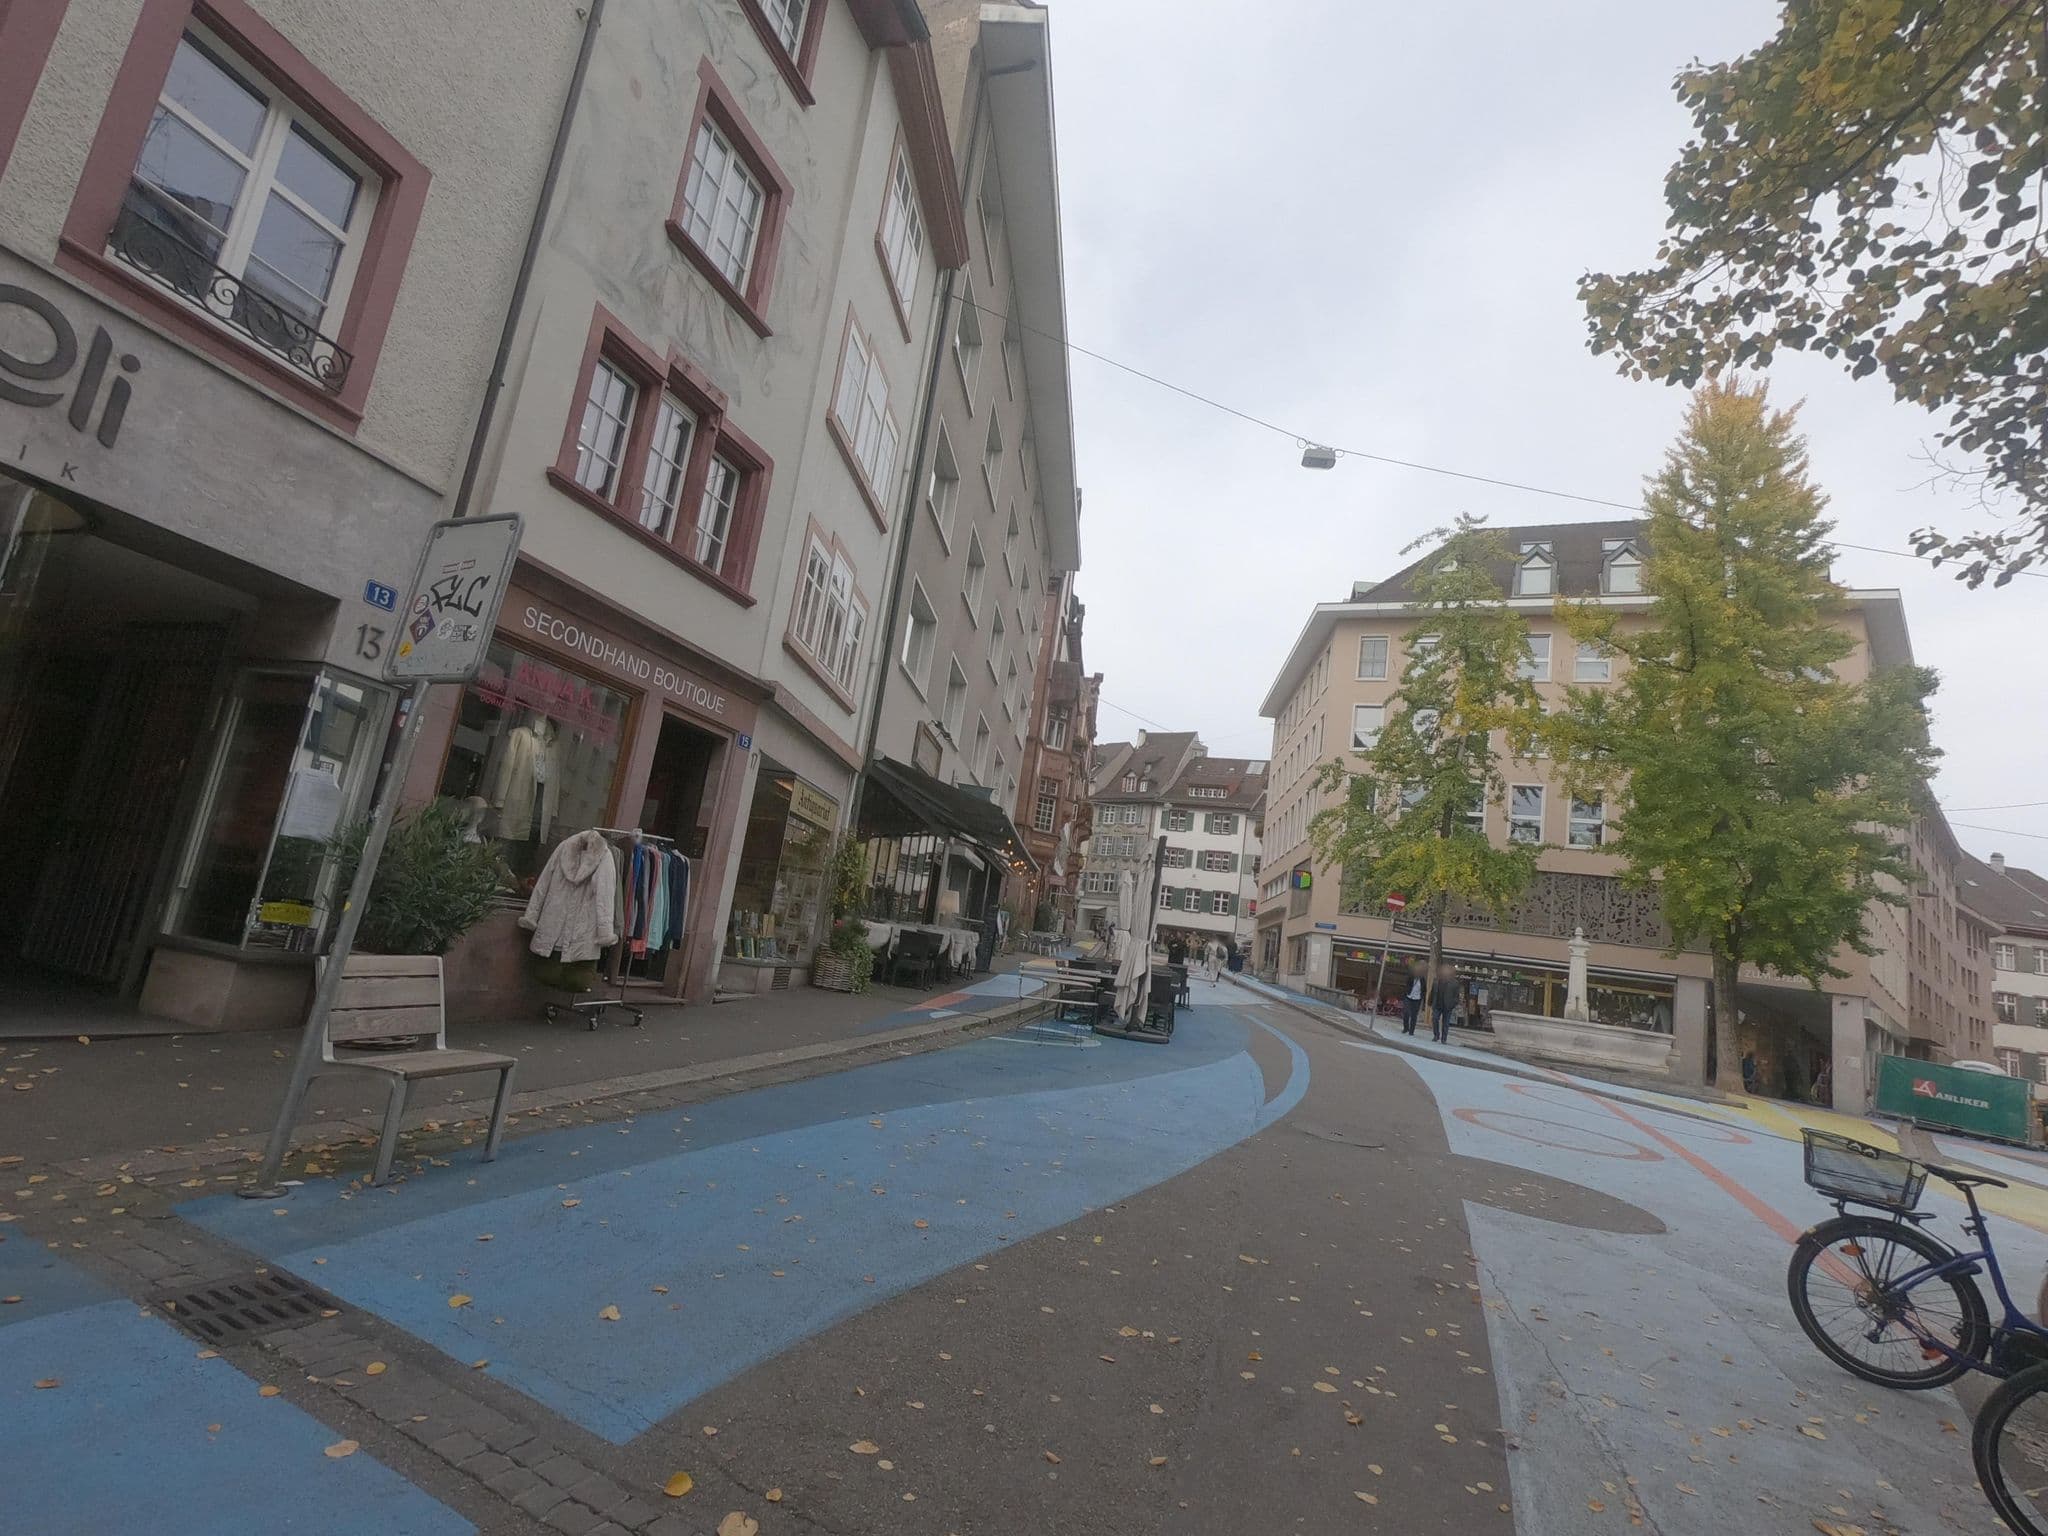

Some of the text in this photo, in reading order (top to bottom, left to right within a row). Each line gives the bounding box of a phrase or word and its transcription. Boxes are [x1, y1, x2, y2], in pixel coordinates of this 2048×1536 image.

[373, 586, 390, 605] 13
[356, 623, 385, 660] 13
[523, 607, 650, 679] SECONDHAND
[653, 666, 726, 715] BOUTIQUE
